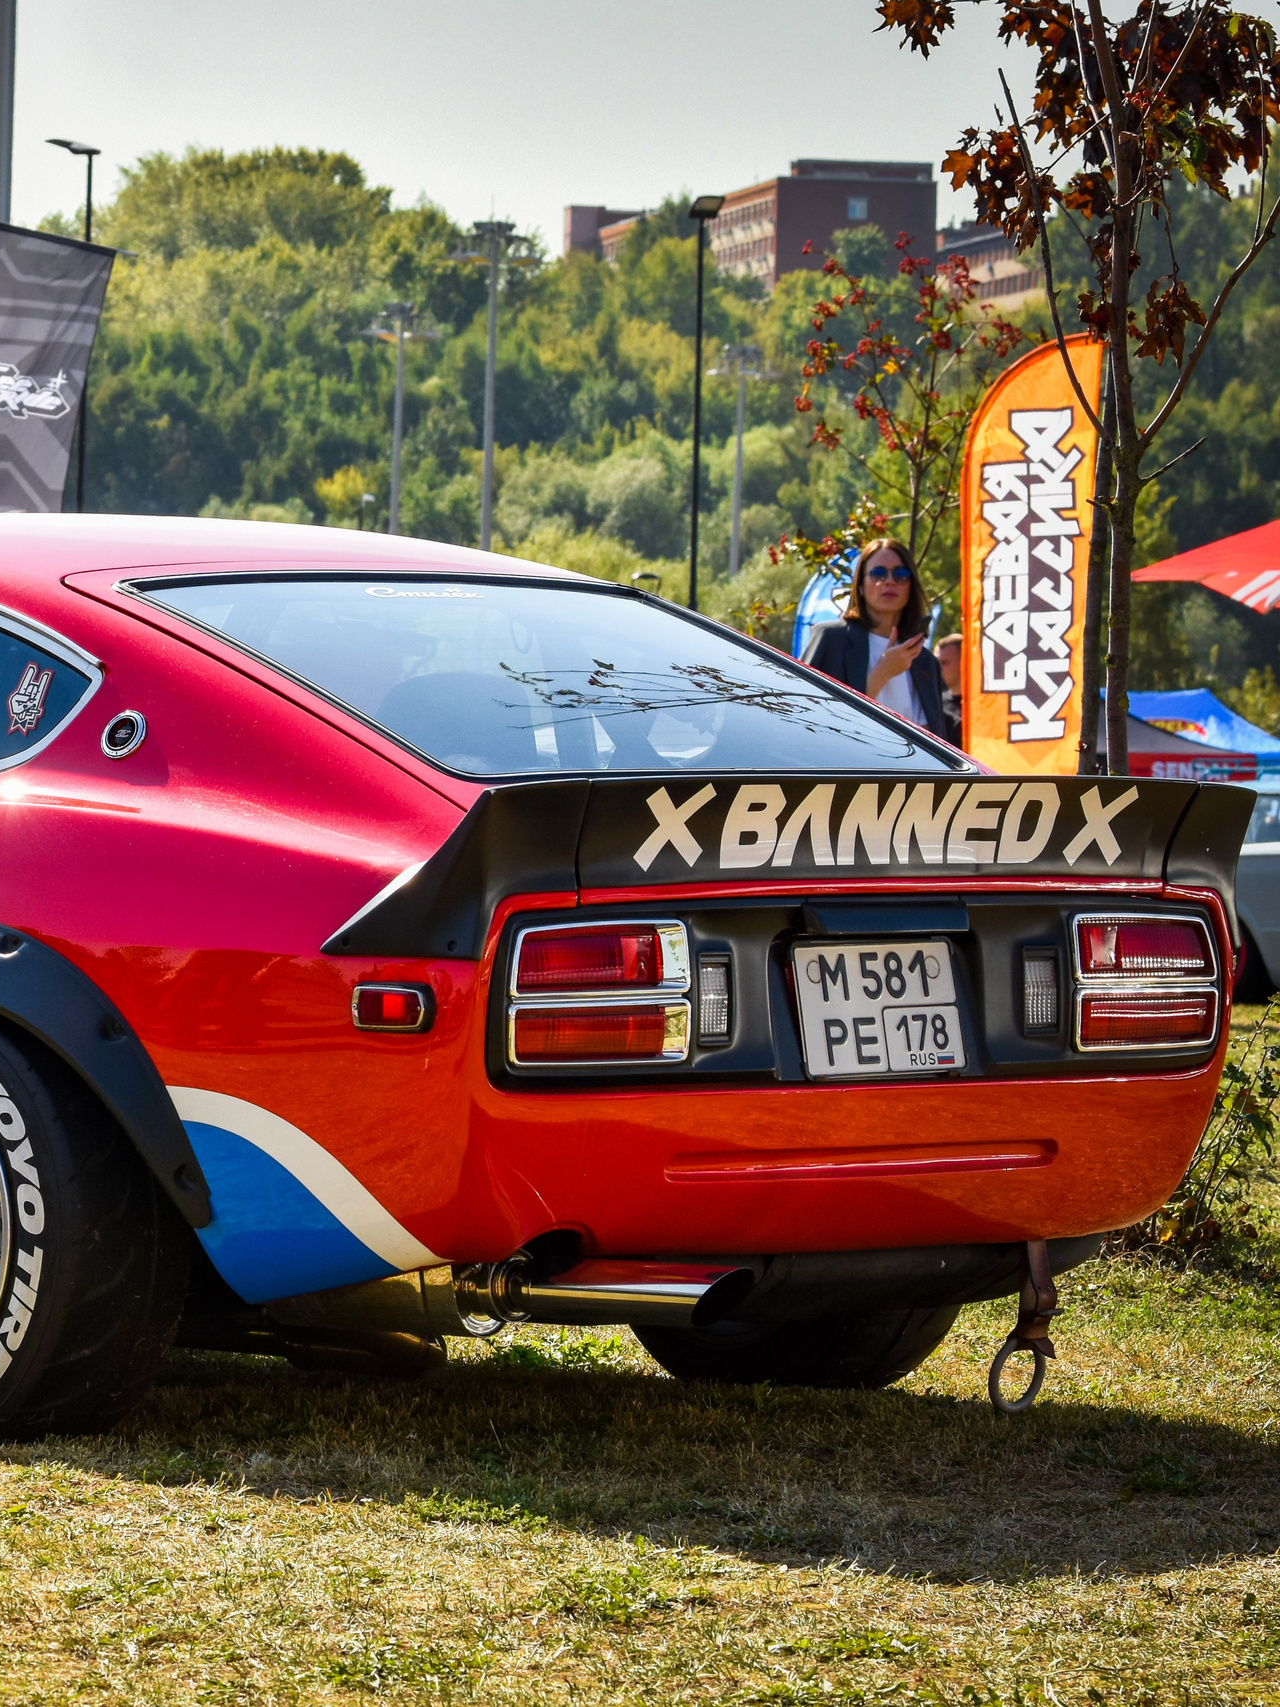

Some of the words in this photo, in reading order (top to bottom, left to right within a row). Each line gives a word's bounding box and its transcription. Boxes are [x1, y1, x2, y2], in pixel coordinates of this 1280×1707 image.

[982, 463, 1029, 691] БОЕВАЯ
[1010, 409, 1082, 741] КЛАССИКА
[632, 782, 717, 872] X
[720, 782, 1062, 869] BANNED
[1062, 784, 1139, 866] X
[818, 953, 850, 1003] M
[858, 950, 930, 1000] 581
[823, 1016, 881, 1067] PE
[896, 1014, 950, 1052] 178
[909, 1053, 936, 1067] RUS
